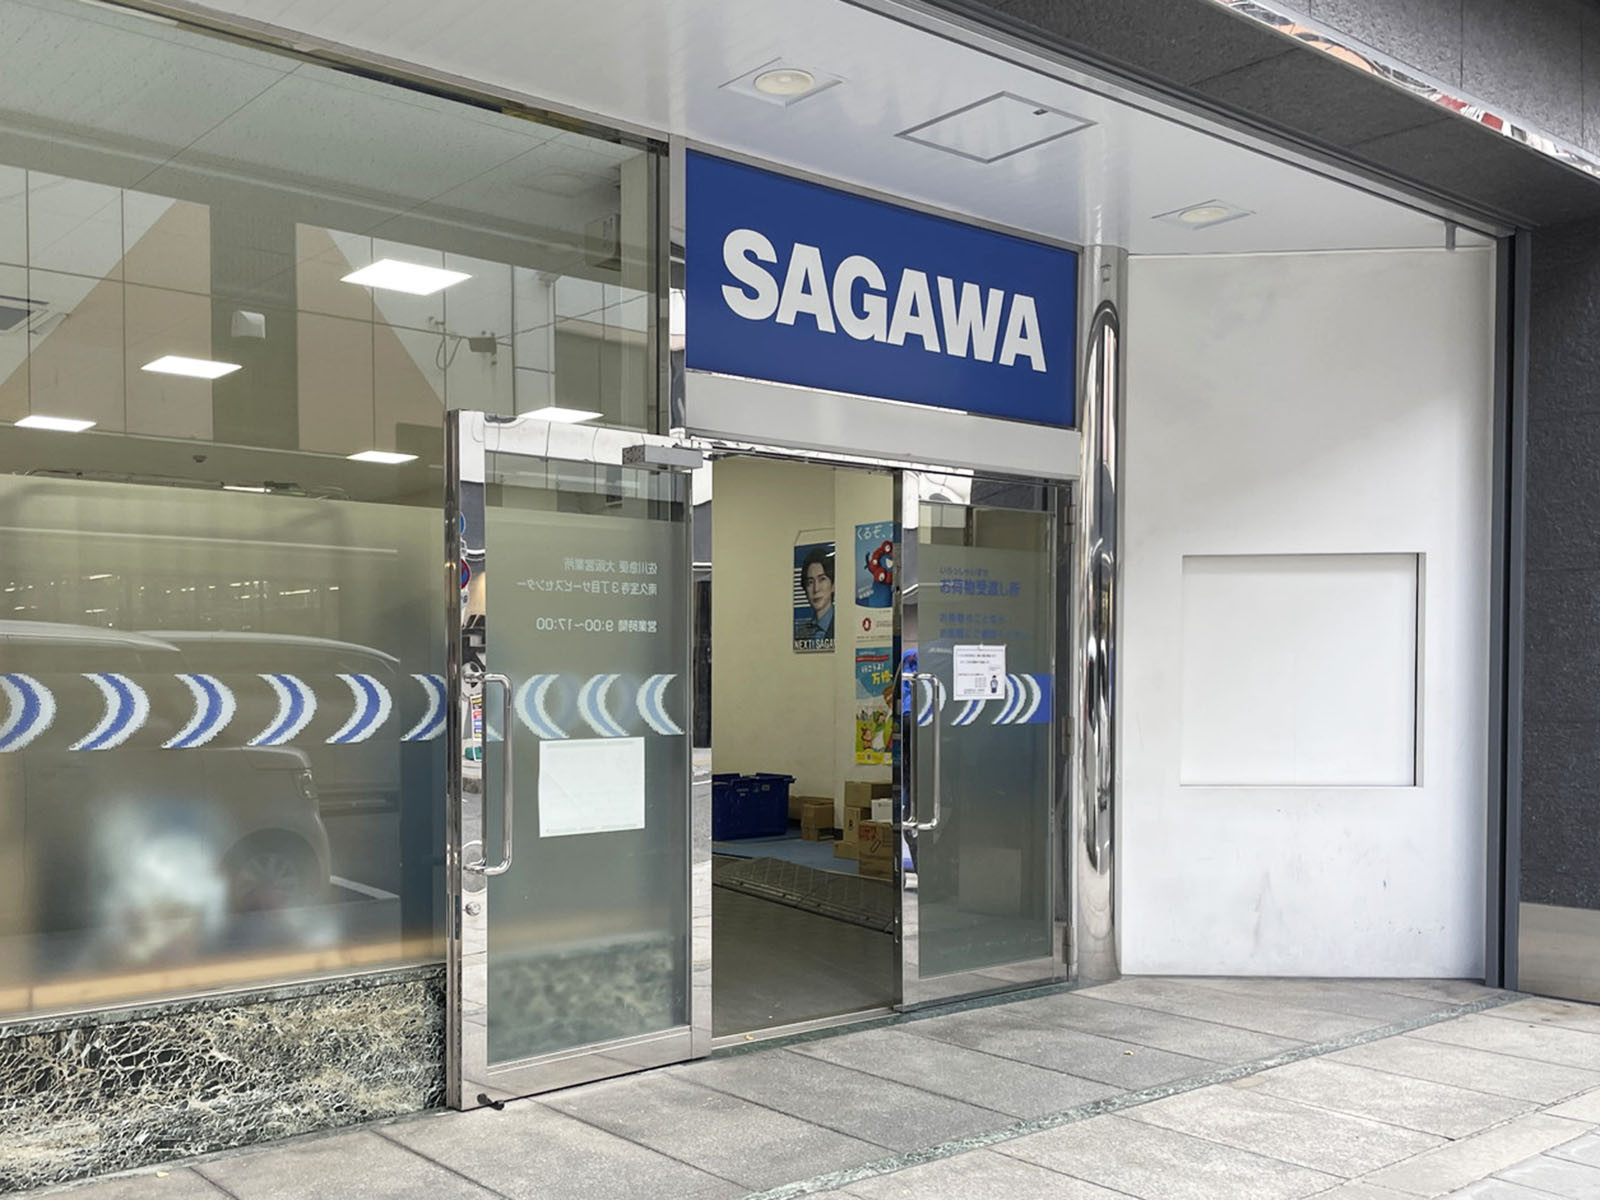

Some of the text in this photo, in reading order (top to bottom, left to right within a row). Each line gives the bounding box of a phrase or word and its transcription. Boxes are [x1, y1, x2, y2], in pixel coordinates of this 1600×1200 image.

[721, 228, 1047, 373] SAGAWA
[857, 523, 893, 541] くるぞ、
